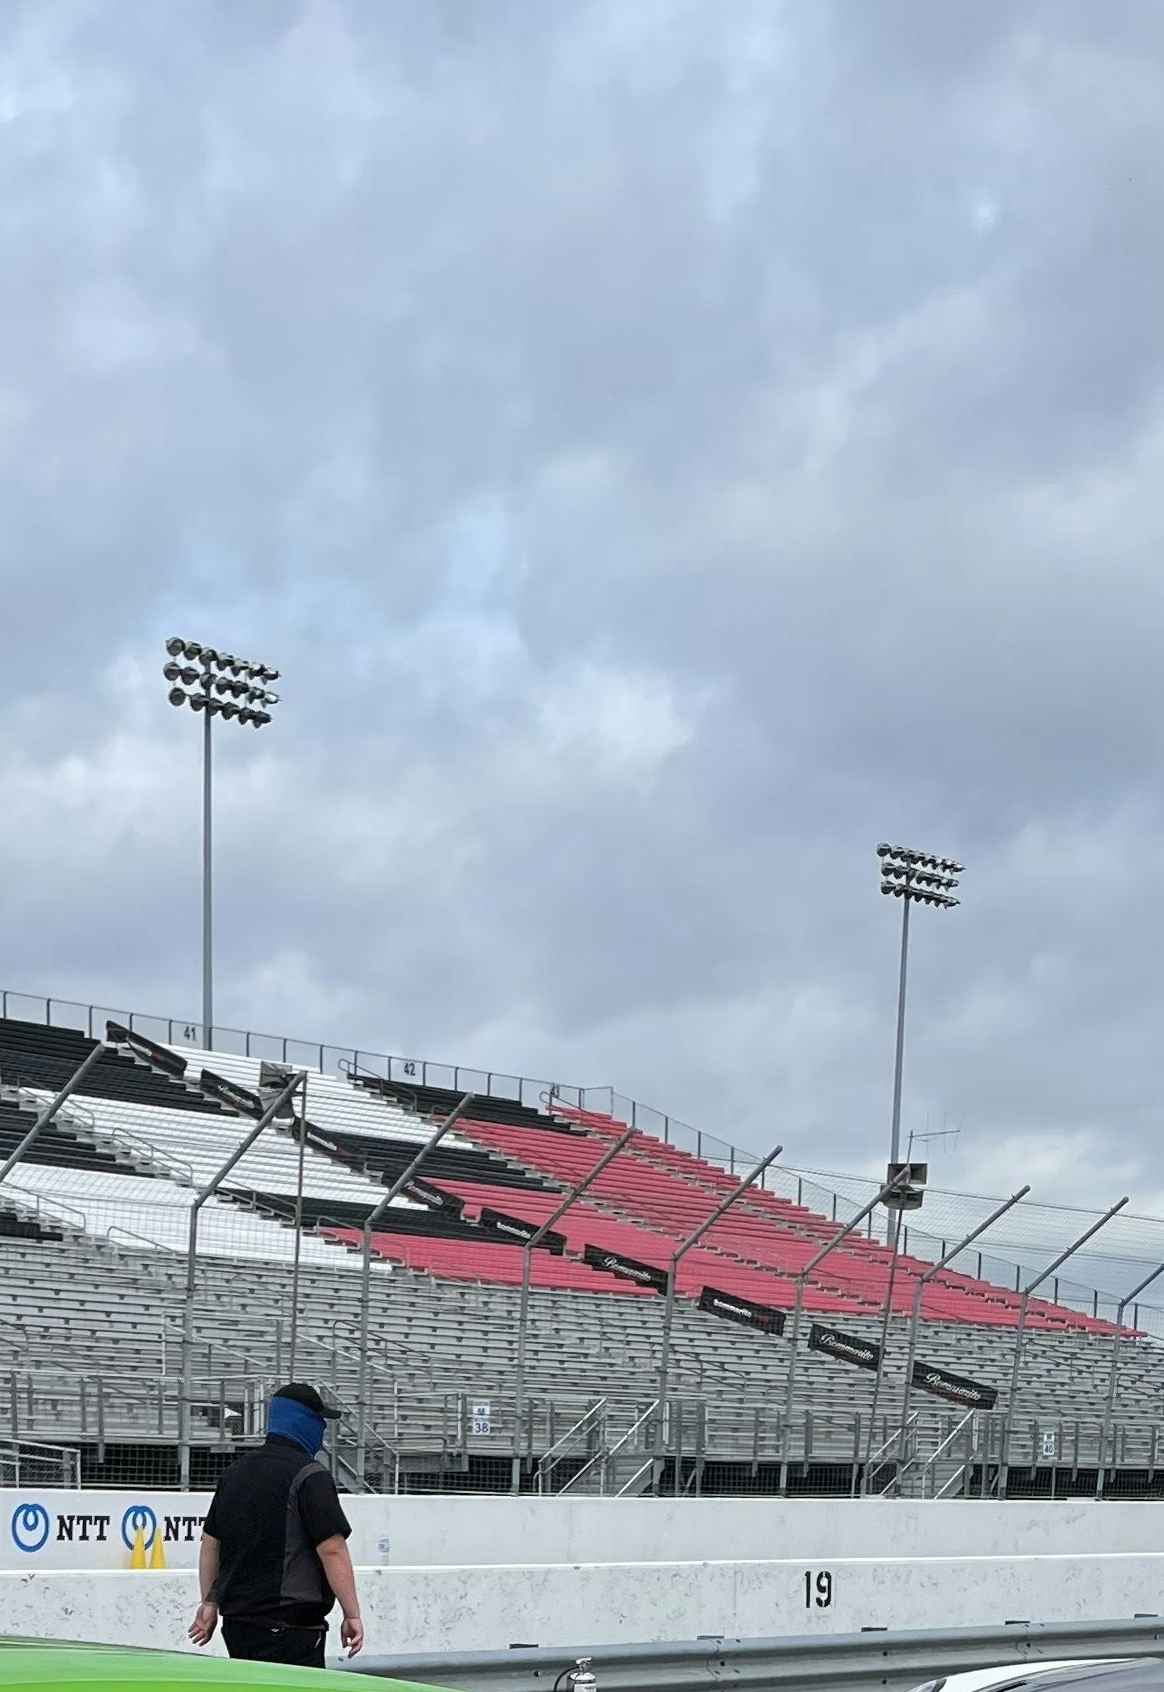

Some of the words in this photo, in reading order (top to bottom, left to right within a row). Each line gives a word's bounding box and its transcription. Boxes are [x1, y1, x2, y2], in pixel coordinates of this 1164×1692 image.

[183, 1025, 197, 1041] 41
[403, 1062, 416, 1077] 42
[474, 1422, 489, 1434] 38
[56, 1515, 111, 1541] NTT
[804, 1570, 832, 1608] 19
